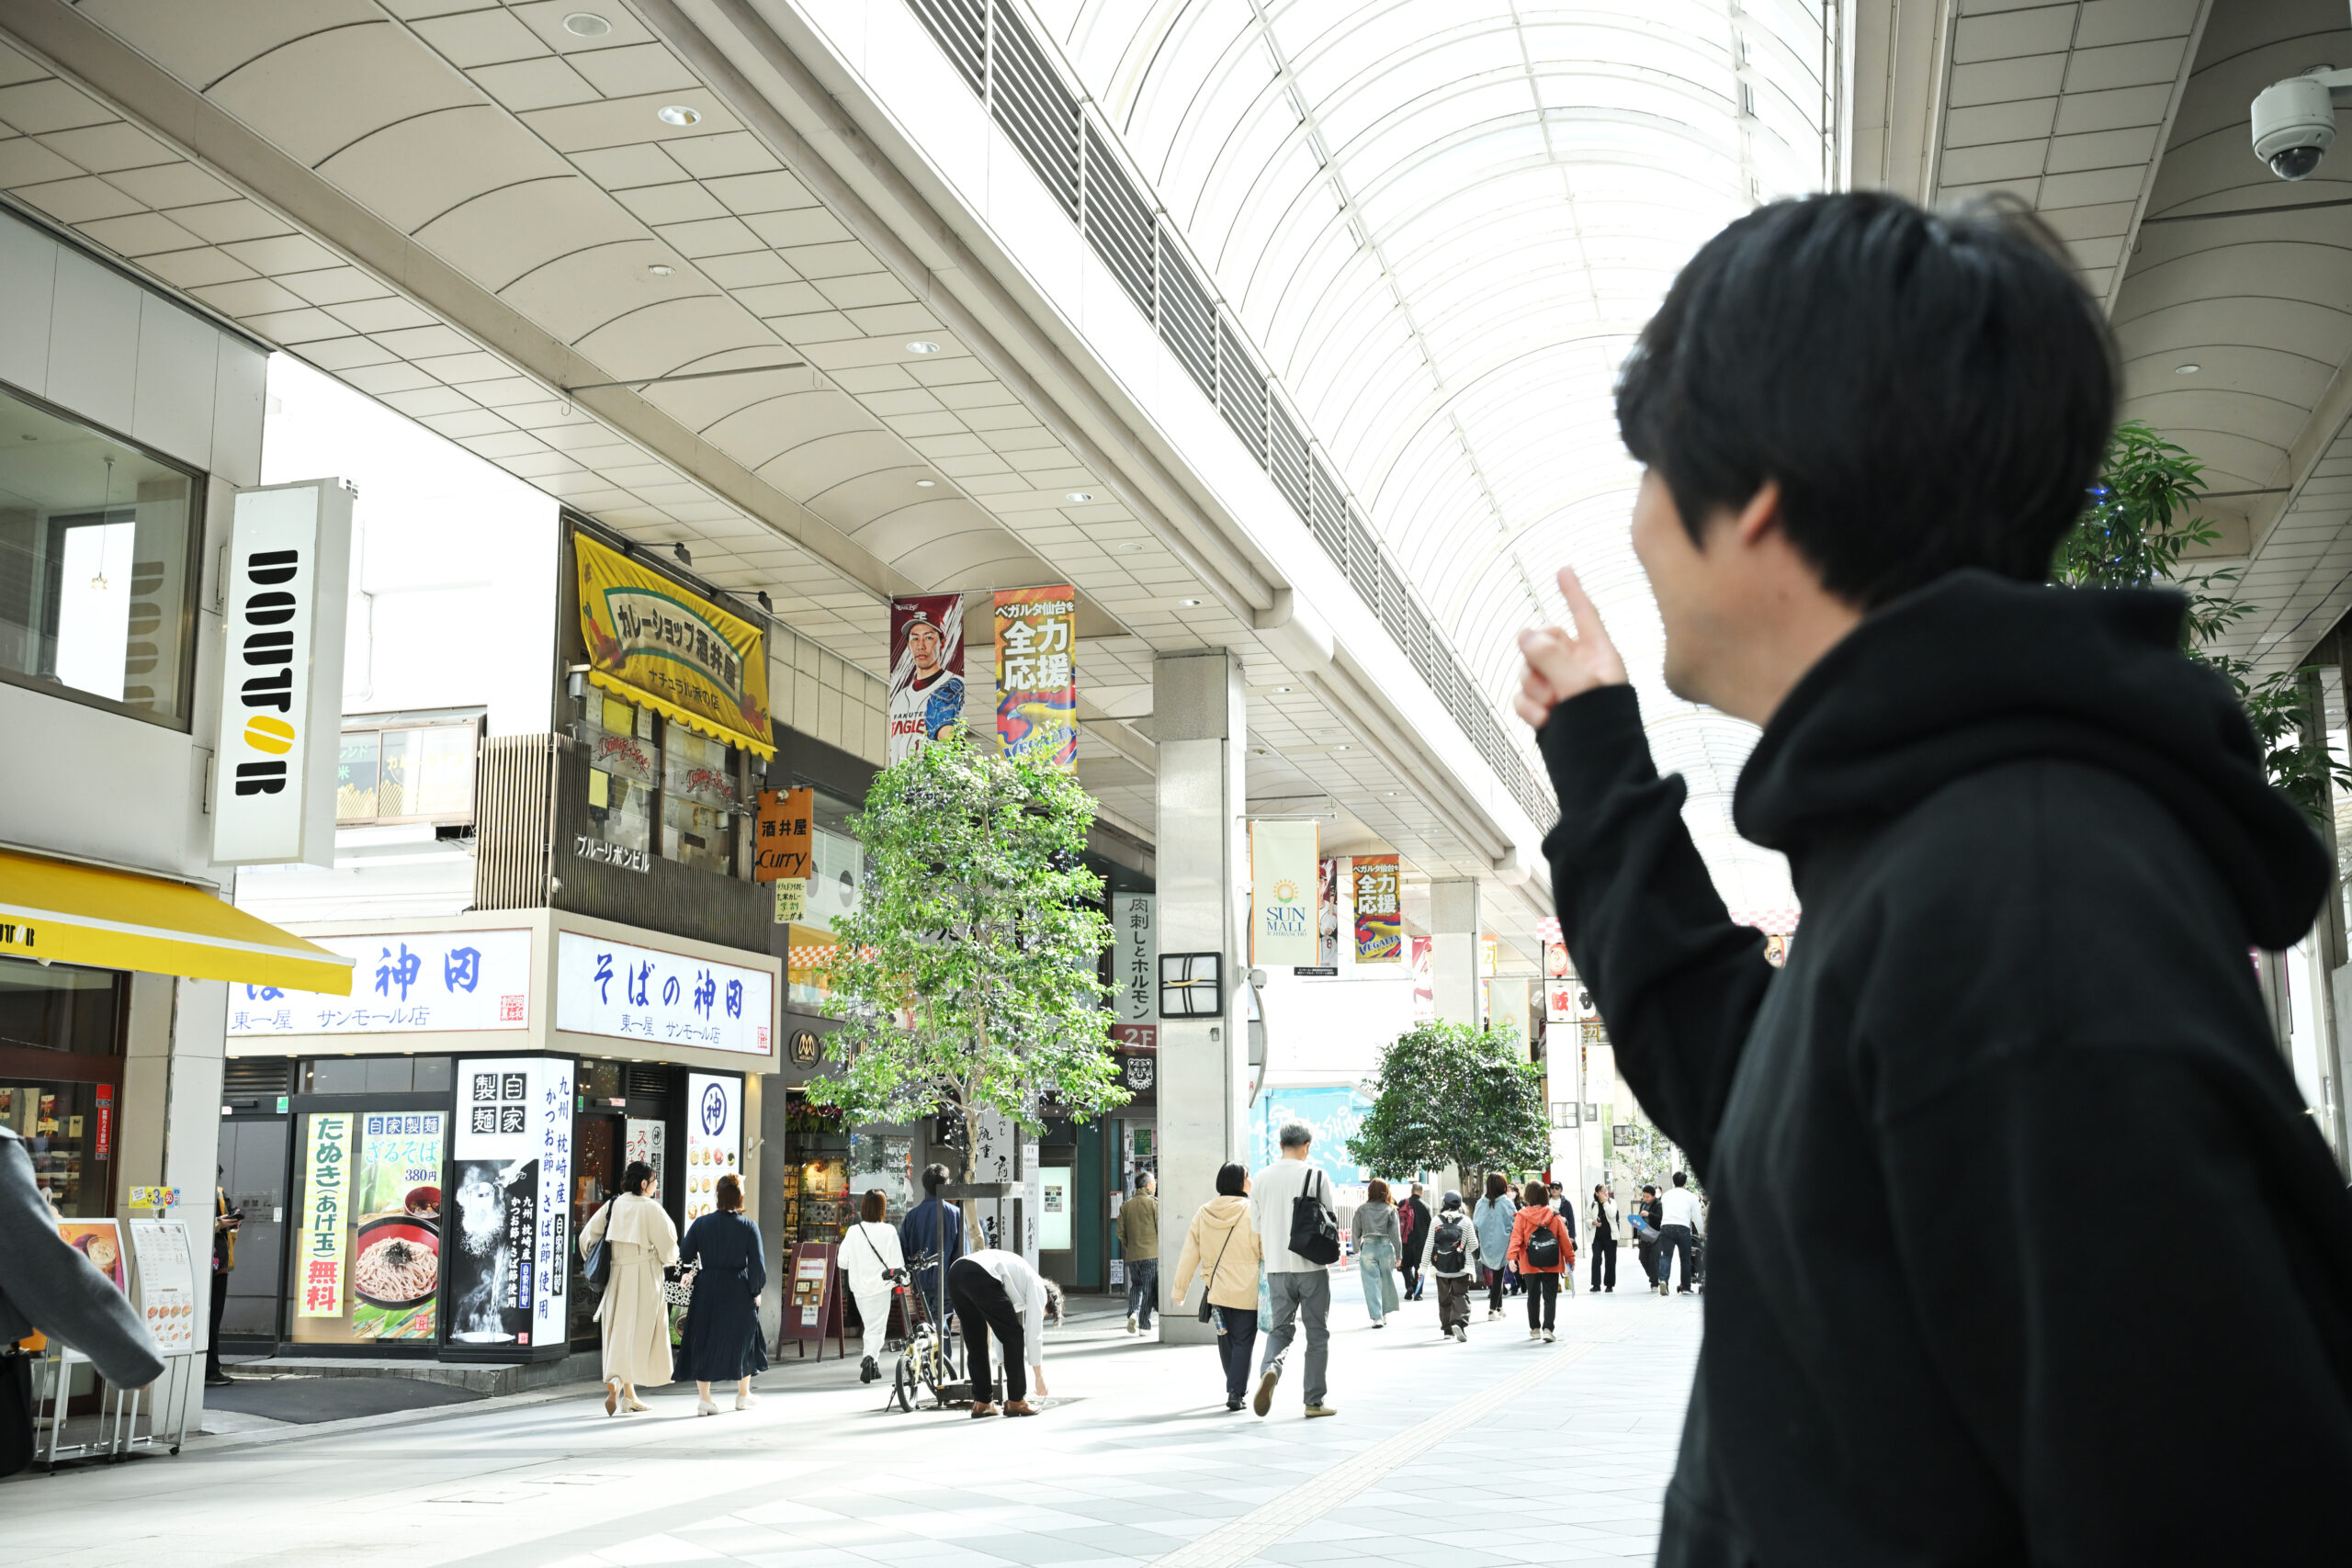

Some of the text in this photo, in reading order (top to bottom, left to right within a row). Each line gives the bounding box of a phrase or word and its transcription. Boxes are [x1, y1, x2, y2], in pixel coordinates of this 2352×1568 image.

[995, 603, 1074, 618] ベガルタ仙台を
[617, 604, 737, 691] カレーショップ酒井屋
[1004, 618, 1068, 656] 全力
[235, 549, 299, 796] DOUTOR
[1003, 653, 1069, 691] 応援
[893, 711, 927, 721] RAKUTE
[1001, 725, 1076, 763] VEGLTA
[762, 818, 808, 837] 酒井屋
[576, 835, 650, 873] ブルーリボンビル
[758, 849, 808, 875] Curry
[1358, 874, 1396, 894] 全力
[1266, 907, 1306, 922] SUN
[1358, 894, 1396, 915] 応援
[1267, 921, 1306, 932] MALL
[1358, 934, 1400, 956] VEGALTA
[1129, 897, 1149, 1020] 肉刺しとホルモン
[594, 953, 743, 1021] そばの神田
[232, 1006, 430, 1030] 東一屋 サンモール店
[620, 1014, 720, 1044] 東一屋 サンモール店
[1124, 1028, 1155, 1047] 2F
[558, 1076, 570, 1121] 九州
[368, 1115, 439, 1135] 自家製麺
[365, 1140, 441, 1163] ざるそば
[405, 1169, 437, 1182] 380円
[306, 1117, 344, 1312] たぬき(あげ玉)無料
[537, 1088, 557, 1320] かつお節・さば節使用
[507, 1196, 522, 1309] かつお節・さば節使用
